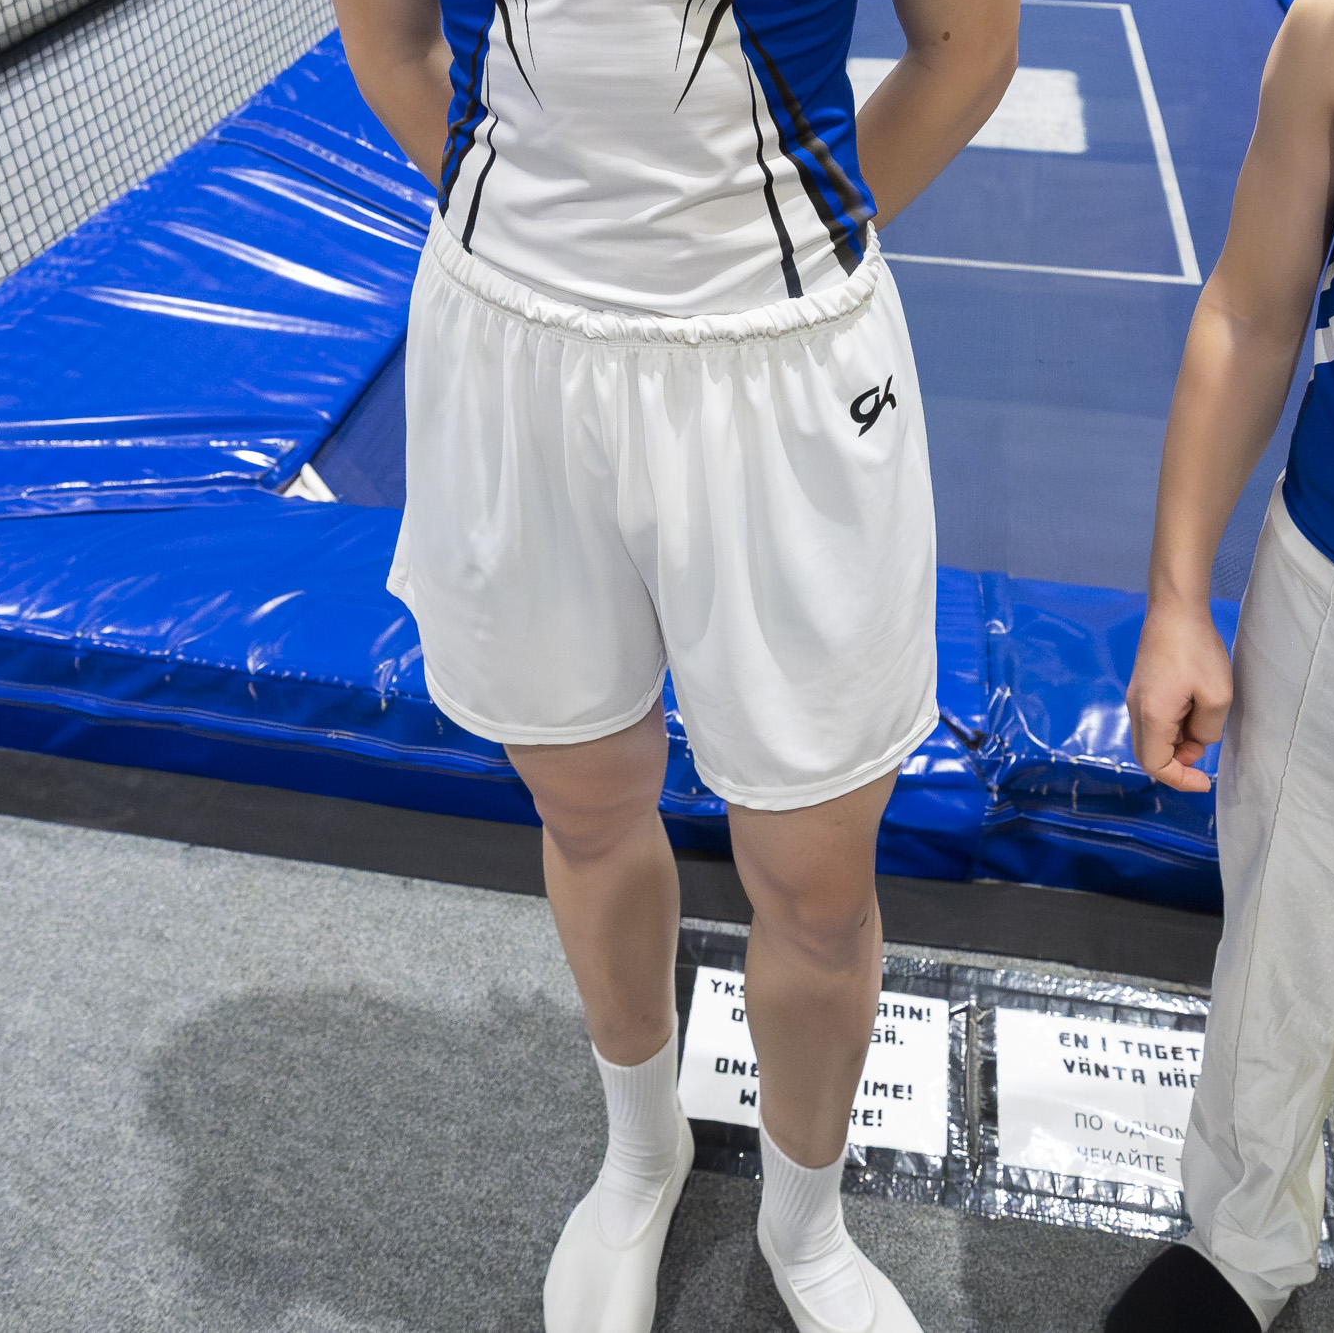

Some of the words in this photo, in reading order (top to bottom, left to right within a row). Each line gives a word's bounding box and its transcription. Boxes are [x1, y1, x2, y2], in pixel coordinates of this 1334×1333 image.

[1058, 1032, 1089, 1049] EN
[1101, 1037, 1107, 1052] I
[1119, 1040, 1201, 1062] TAGET
[1063, 1056, 1146, 1085] VÄNTA
[1074, 1112, 1103, 1131] ПО
